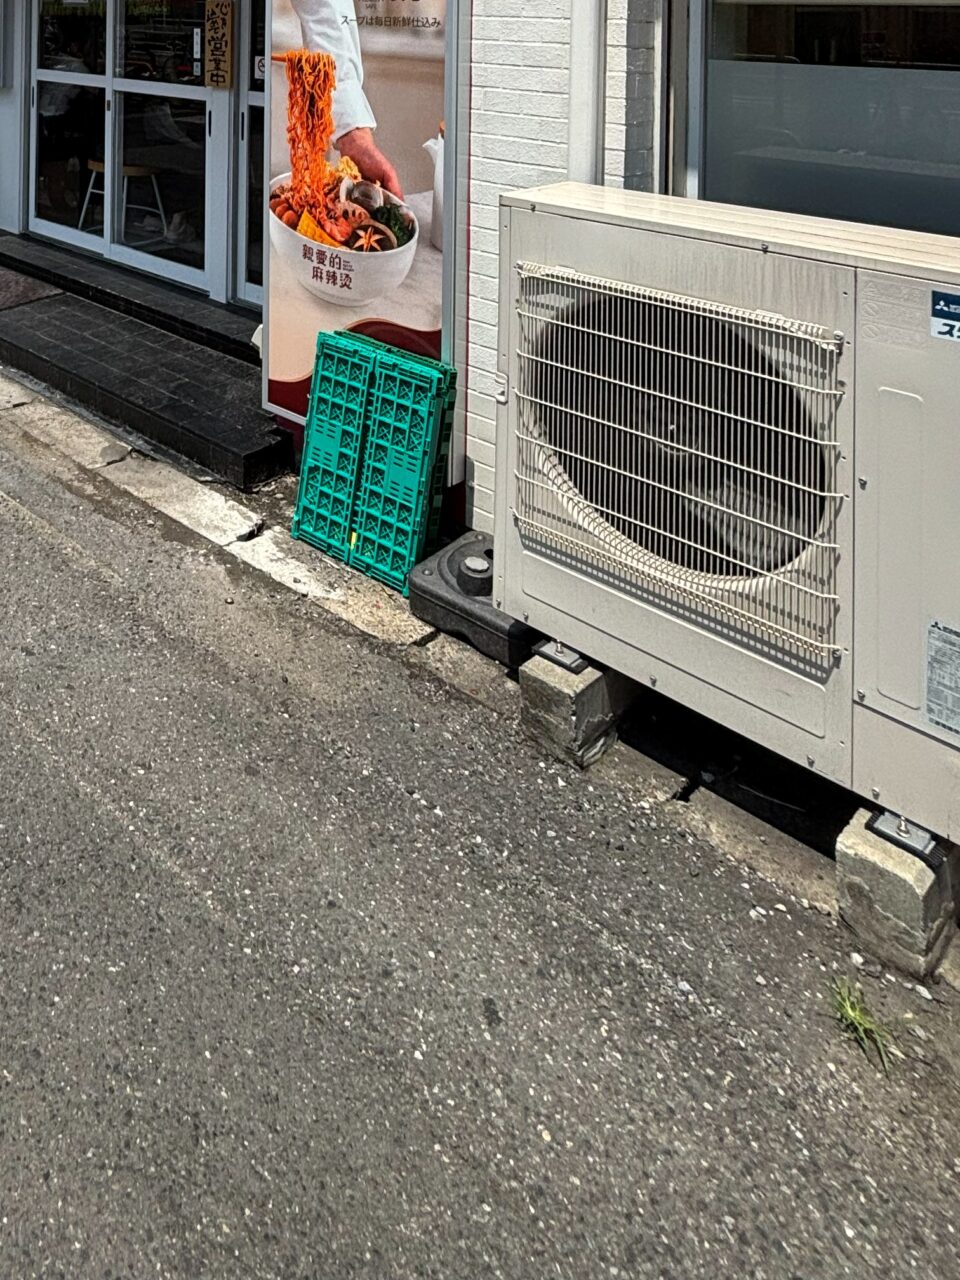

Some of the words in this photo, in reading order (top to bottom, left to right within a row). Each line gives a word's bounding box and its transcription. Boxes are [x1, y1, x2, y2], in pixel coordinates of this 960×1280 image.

[341, 15, 441, 29] スープは毎日新鮮仕込み
[207, 33, 228, 86] 営業中
[302, 243, 342, 270] 親愛的
